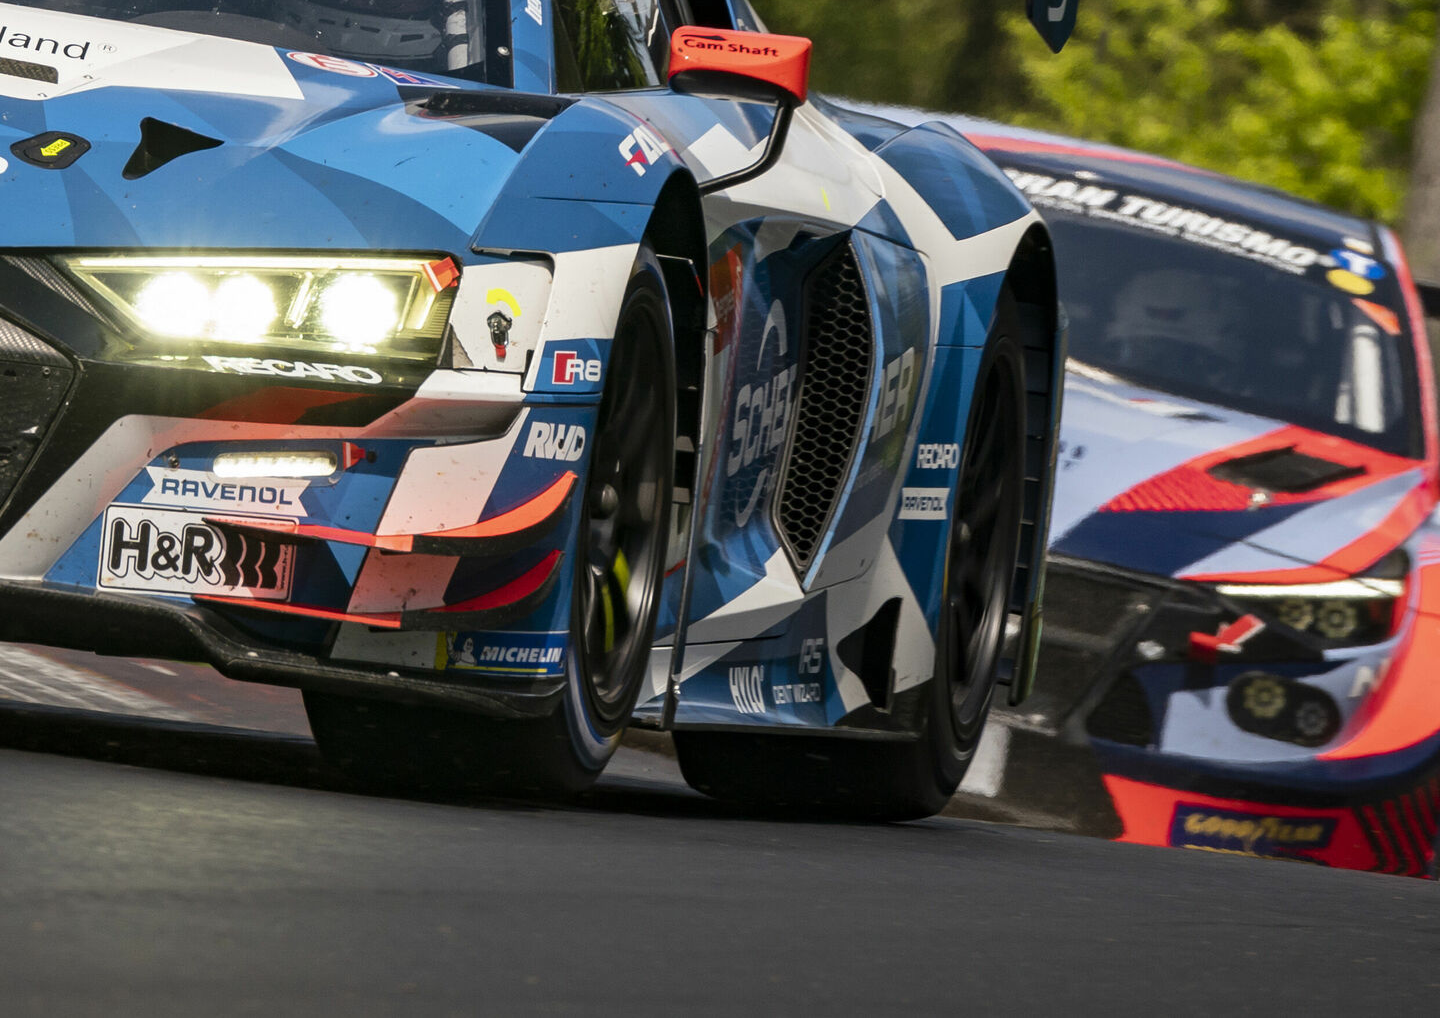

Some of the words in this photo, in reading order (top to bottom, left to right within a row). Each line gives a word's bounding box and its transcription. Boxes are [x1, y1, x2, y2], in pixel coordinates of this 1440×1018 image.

[684, 39, 723, 51] Cam
[728, 43, 779, 57] Shaft
[1118, 195, 1320, 268] TURISMO
[201, 355, 383, 385] RECARO
[564, 358, 601, 383] R8
[916, 443, 960, 469] RECARO
[161, 479, 293, 506] RAVENOL
[108, 518, 222, 585] H&R
[480, 645, 563, 664] MICHELIN
